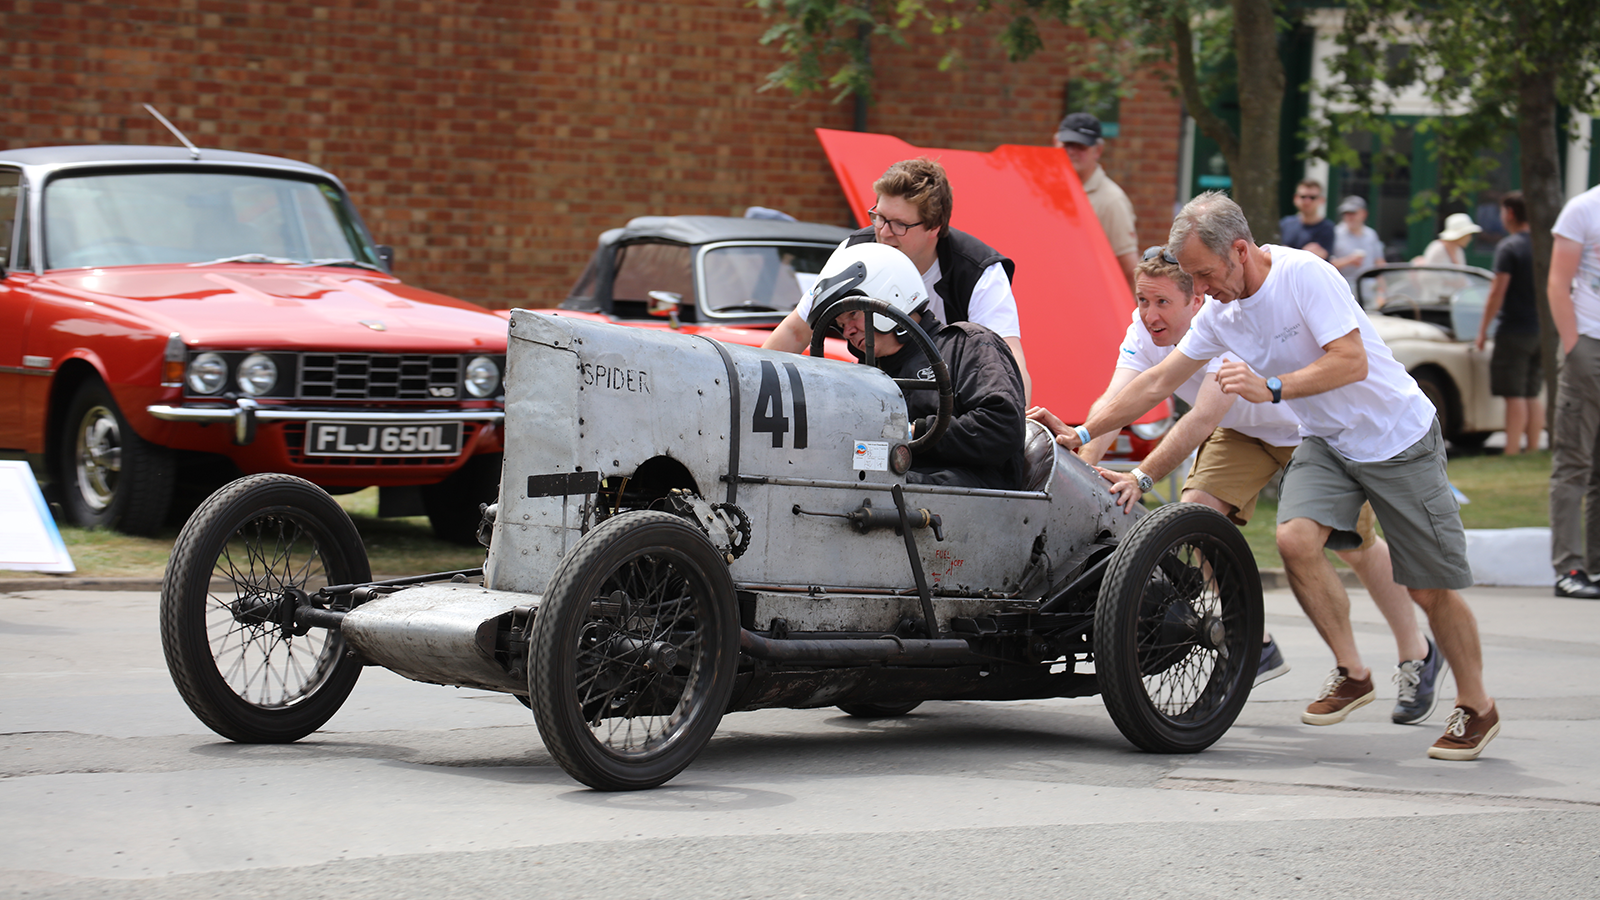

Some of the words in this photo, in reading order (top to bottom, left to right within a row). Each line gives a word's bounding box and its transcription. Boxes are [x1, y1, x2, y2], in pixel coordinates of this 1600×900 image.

[584, 363, 651, 395] SPIDER
[752, 360, 808, 449] 41
[317, 426, 378, 451] FLJ
[380, 426, 452, 451] 650L
[936, 550, 950, 559] FUEL
